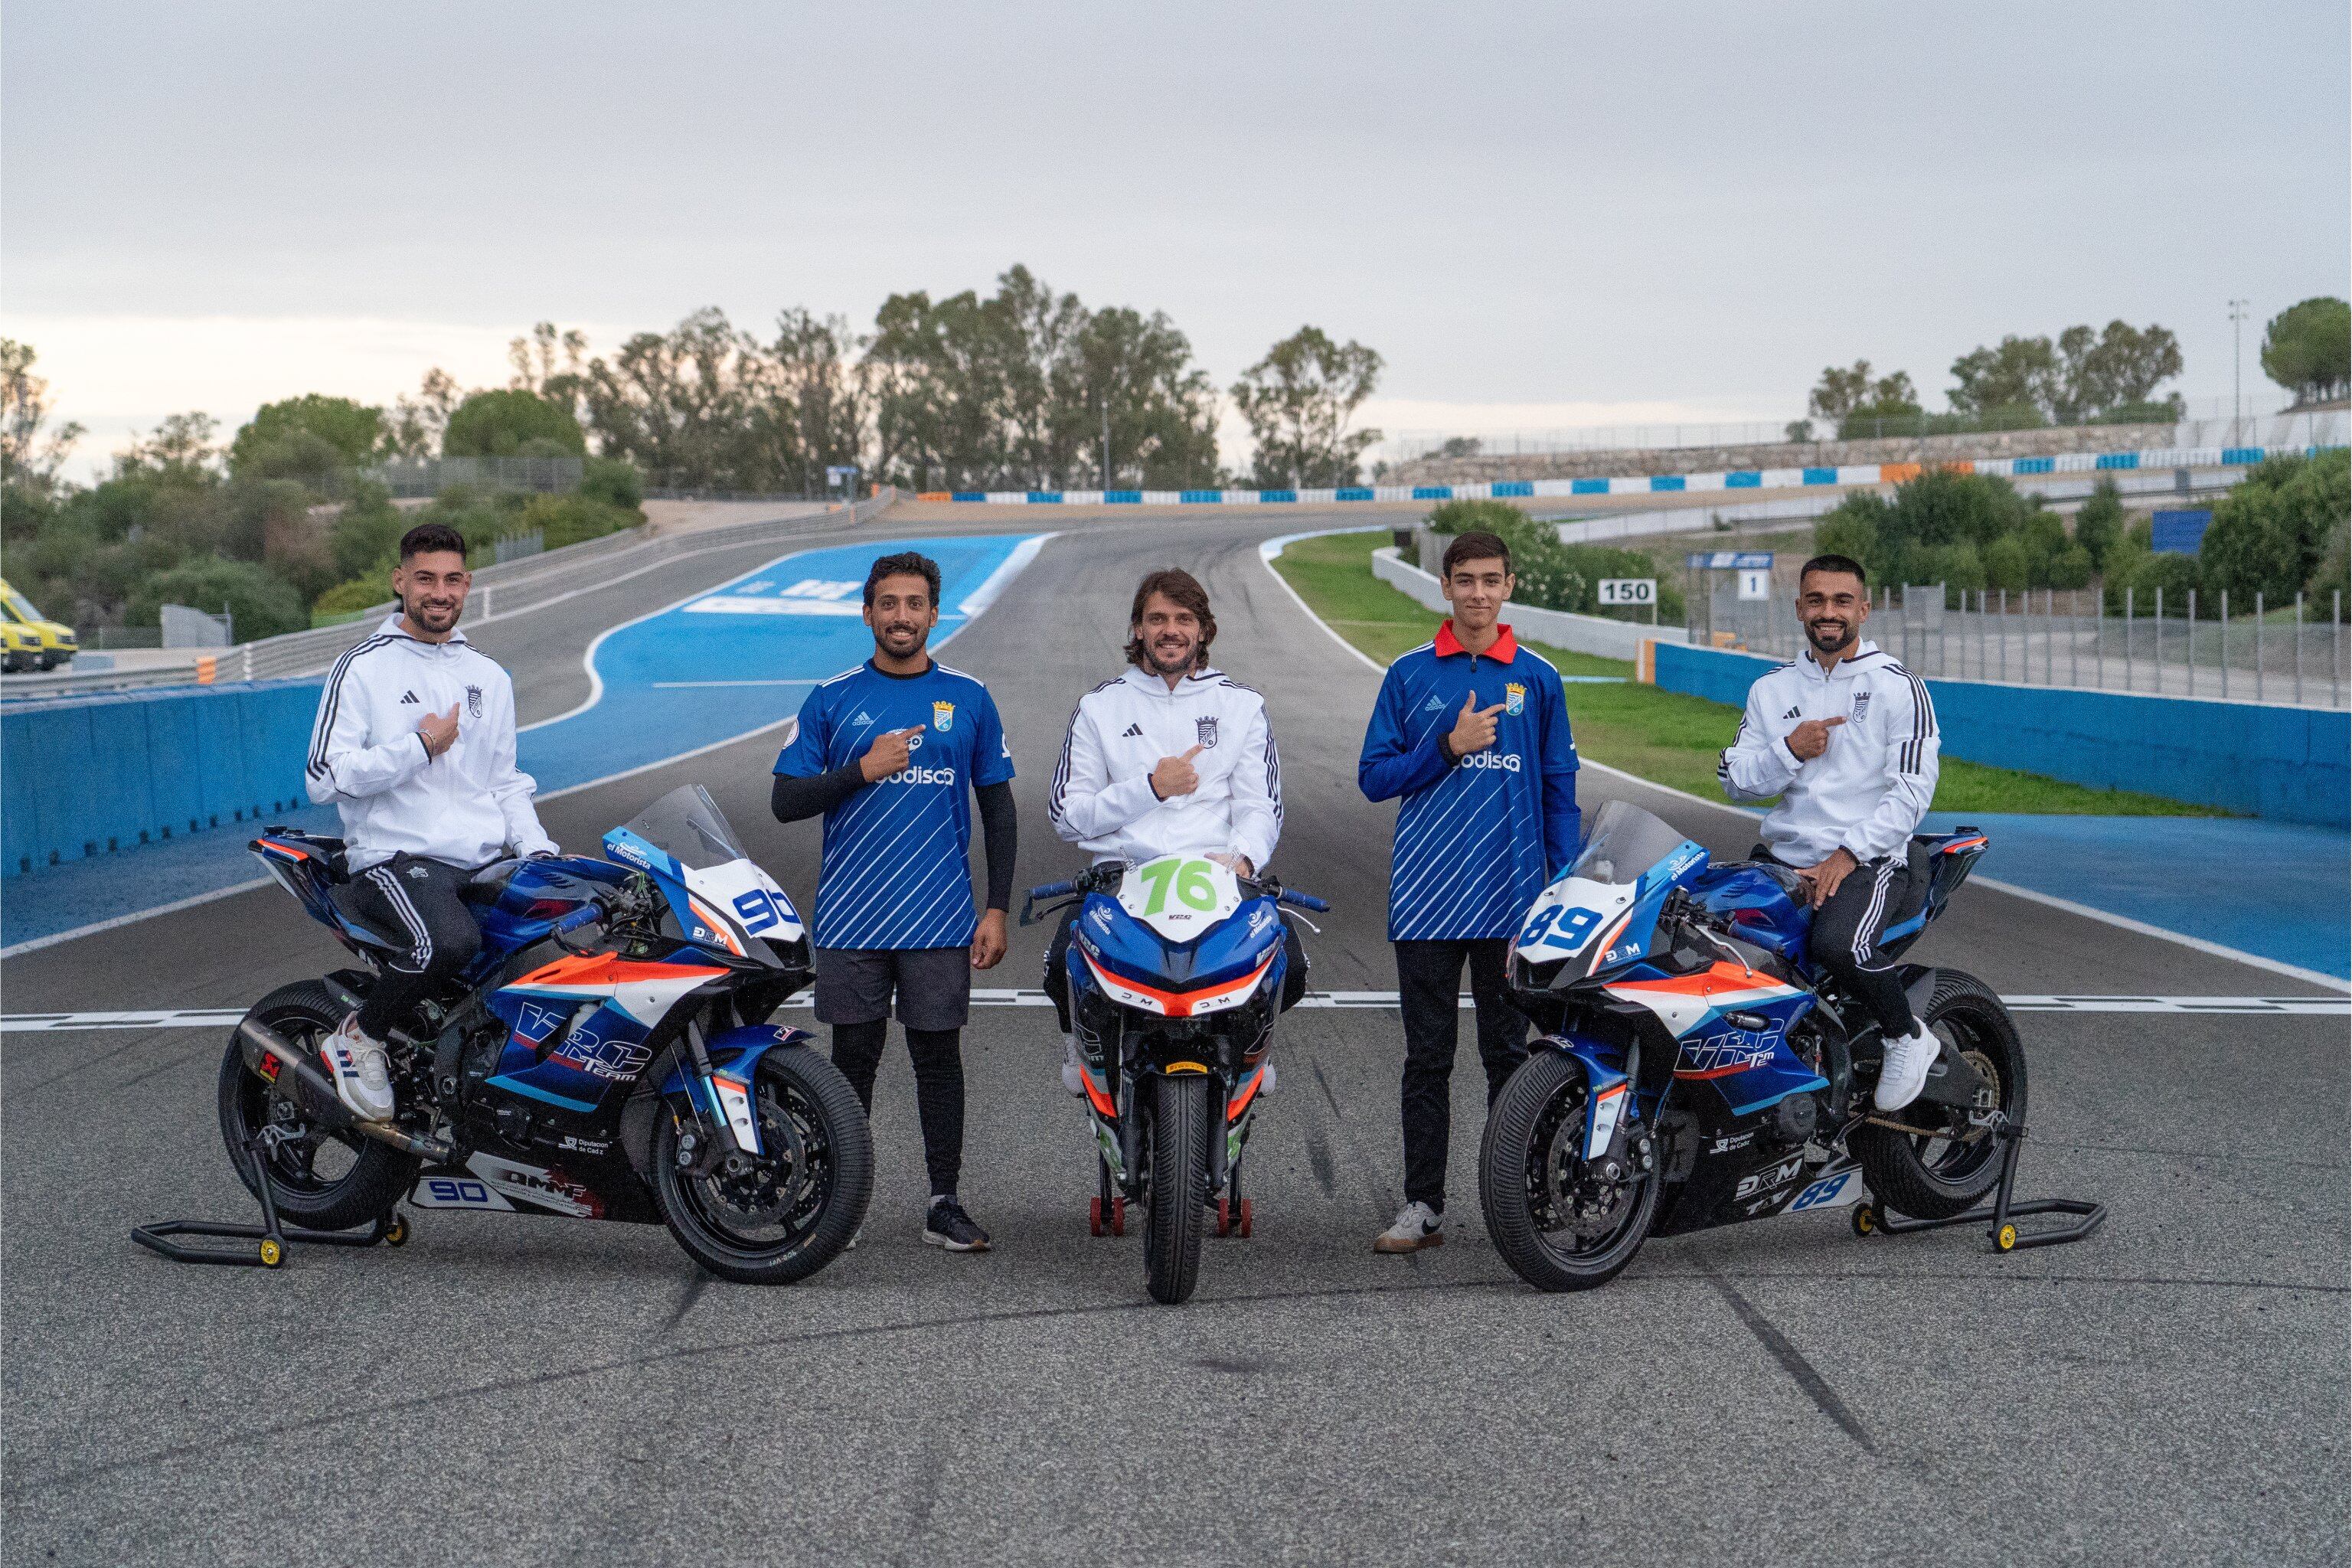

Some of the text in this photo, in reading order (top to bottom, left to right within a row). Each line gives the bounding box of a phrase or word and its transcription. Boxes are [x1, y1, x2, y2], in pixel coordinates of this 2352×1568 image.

[1605, 583, 1649, 600] 150
[1750, 575, 1757, 593] 1
[1452, 750, 1521, 773] odisca
[876, 766, 956, 786] odisca
[606, 843, 651, 870] el Motorista
[1671, 851, 1706, 881] el Motorista
[1141, 858, 1217, 916] 76
[732, 888, 801, 936] 90
[1517, 904, 1603, 951] 89
[586, 1147, 604, 1155] Cadz
[429, 1180, 488, 1203] 90
[1735, 1158, 1803, 1198] DRM
[1792, 1172, 1851, 1211] 89
